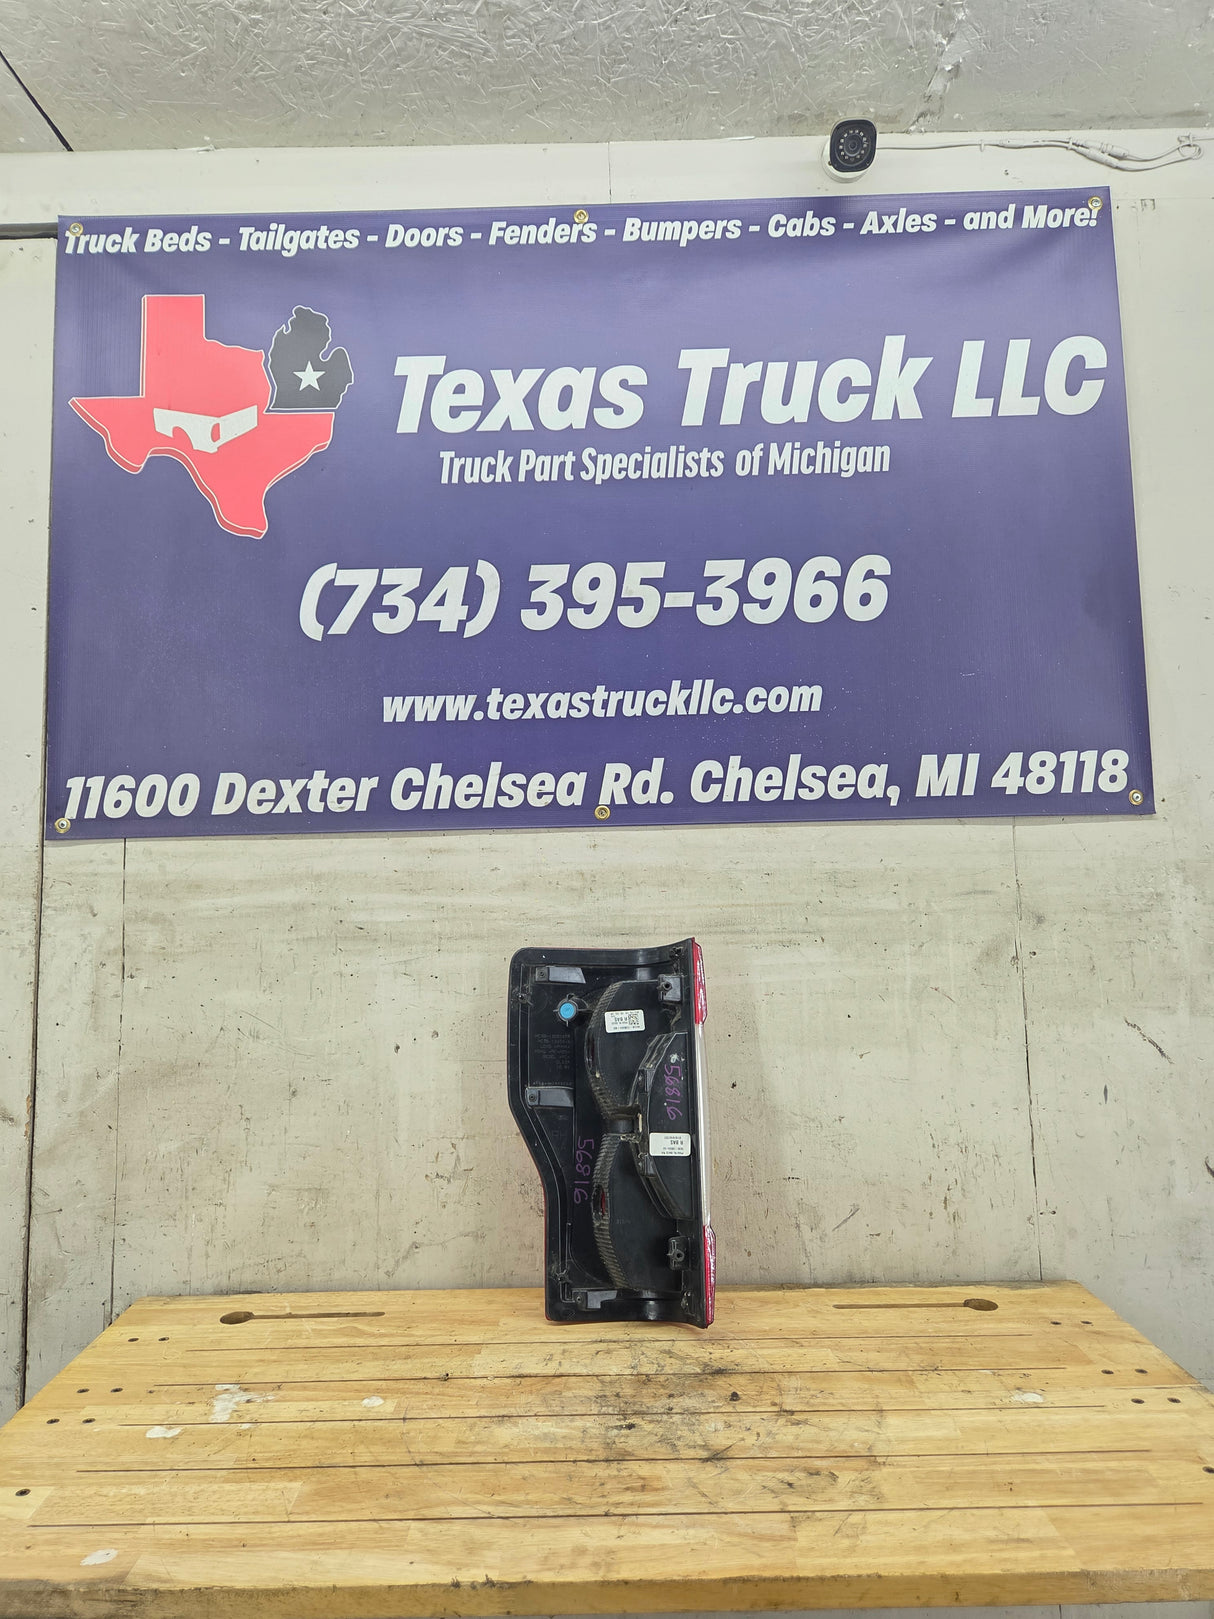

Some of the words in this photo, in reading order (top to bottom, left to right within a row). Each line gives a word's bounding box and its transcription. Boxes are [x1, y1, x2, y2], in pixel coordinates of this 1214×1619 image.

[64, 228, 139, 254] Truck
[143, 225, 213, 253] Beds
[238, 222, 361, 258] Tailgates
[384, 223, 464, 248] Doors
[488, 217, 598, 246] Fenders
[622, 217, 743, 248] Bumpers
[767, 210, 837, 238] Cabs
[859, 207, 938, 235] Axles
[963, 203, 1017, 231] and
[1021, 203, 1099, 229] More!
[393, 355, 648, 434] Texas
[677, 334, 934, 427] Truck
[951, 335, 1108, 418] LLC
[439, 449, 513, 484] Truck
[518, 448, 576, 483] Part
[579, 444, 725, 485] Specialists
[735, 442, 764, 477] of
[767, 440, 891, 478] Michigan
[299, 559, 501, 642] (734)
[520, 554, 892, 631] 395-3966
[383, 678, 823, 723] www.texastruckllc.com
[63, 772, 201, 821] 11600
[211, 769, 380, 816] Dexter
[390, 761, 588, 811] Chelsea
[598, 757, 675, 806] Rd.
[690, 753, 901, 807] Chelsea,
[915, 753, 981, 797] MI
[990, 749, 1129, 795] 48118
[664, 1064, 683, 1121] 56816
[573, 1135, 595, 1204] 56816
